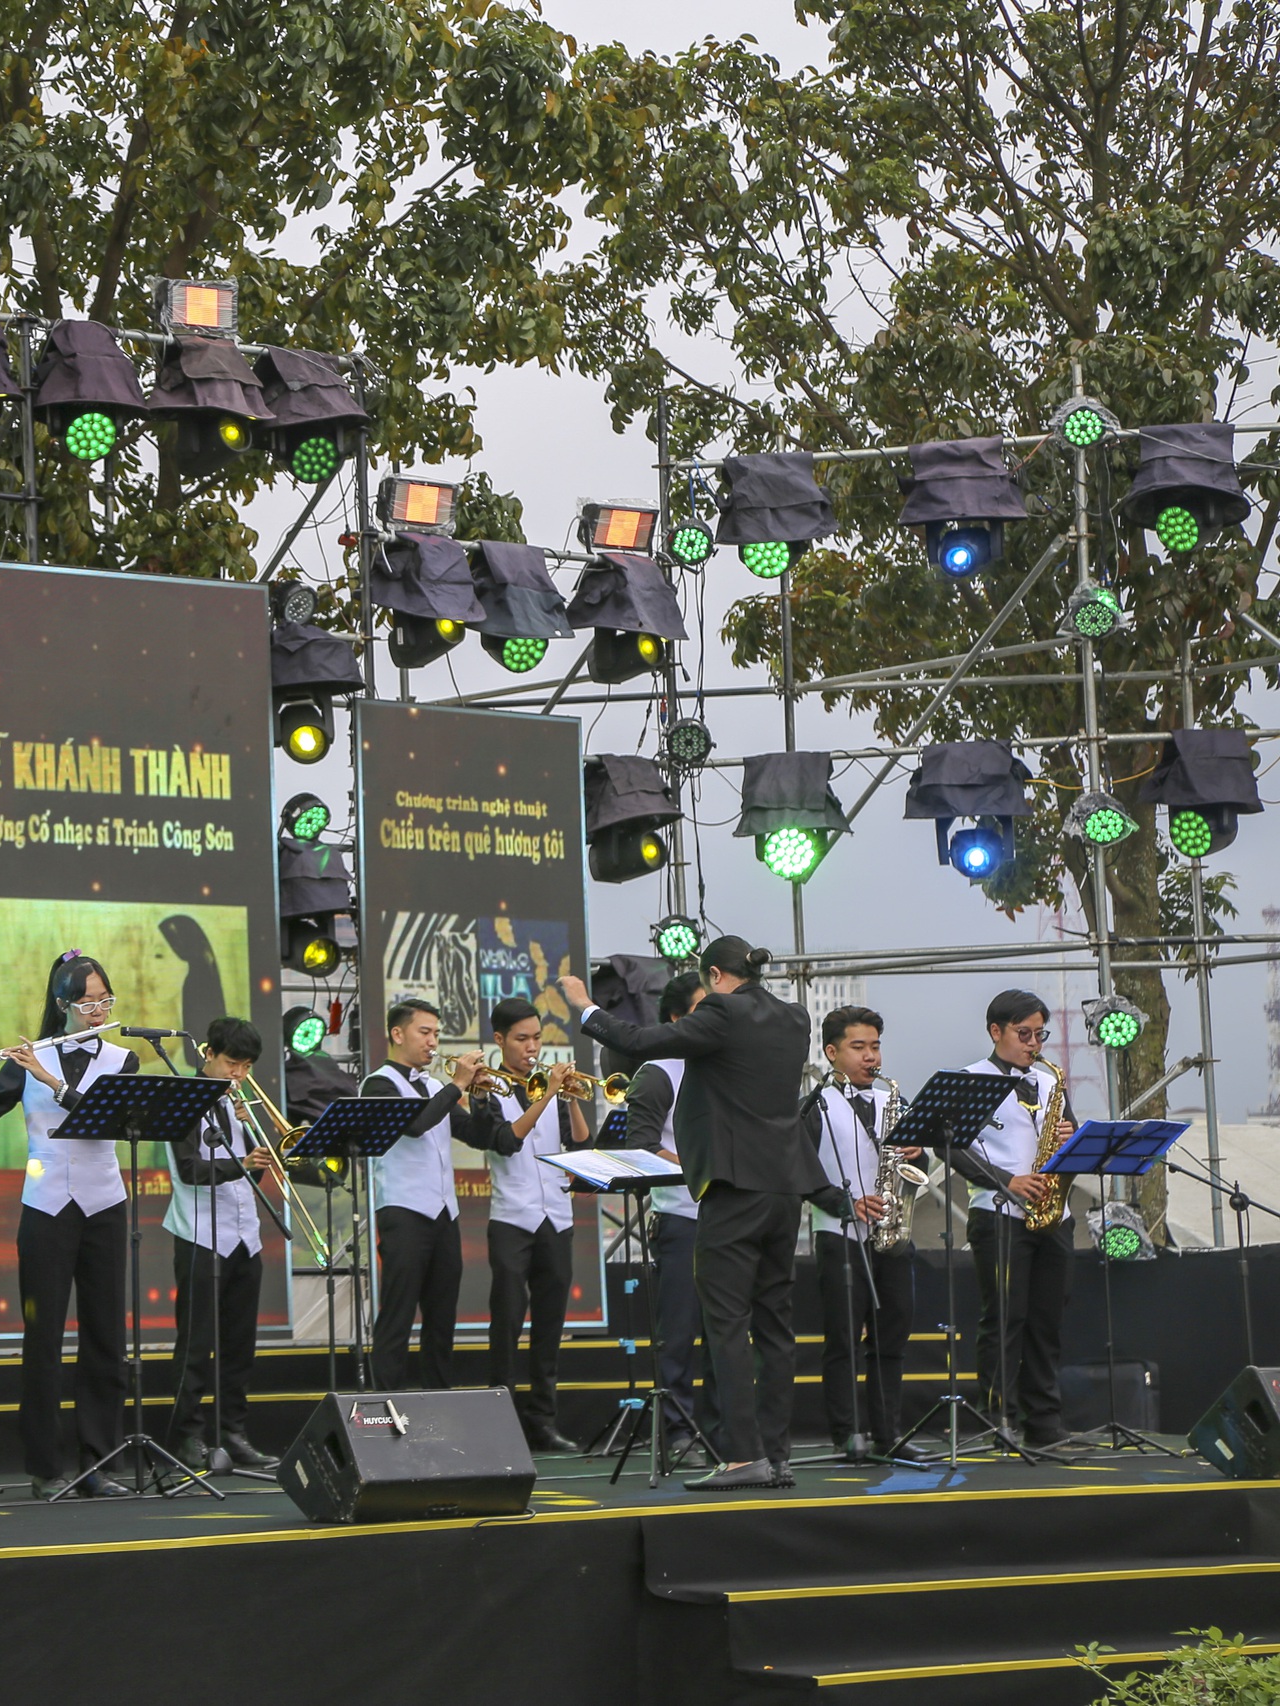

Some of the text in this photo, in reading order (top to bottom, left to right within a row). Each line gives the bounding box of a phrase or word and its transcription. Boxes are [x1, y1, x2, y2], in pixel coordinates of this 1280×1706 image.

[13, 738, 121, 795] KHÁNH
[130, 745, 232, 801] THÀNH
[396, 791, 443, 813] Chương
[482, 798, 511, 817] nghệ
[514, 800, 547, 819] thuật
[28, 809, 51, 843] Cố
[53, 818, 93, 851] nhạc
[96, 817, 111, 846] sĩ
[113, 818, 160, 854] Trịnh
[163, 821, 202, 856] Công
[205, 823, 235, 852] Sơn
[380, 813, 565, 865] Chiều trên quê hương tôi
